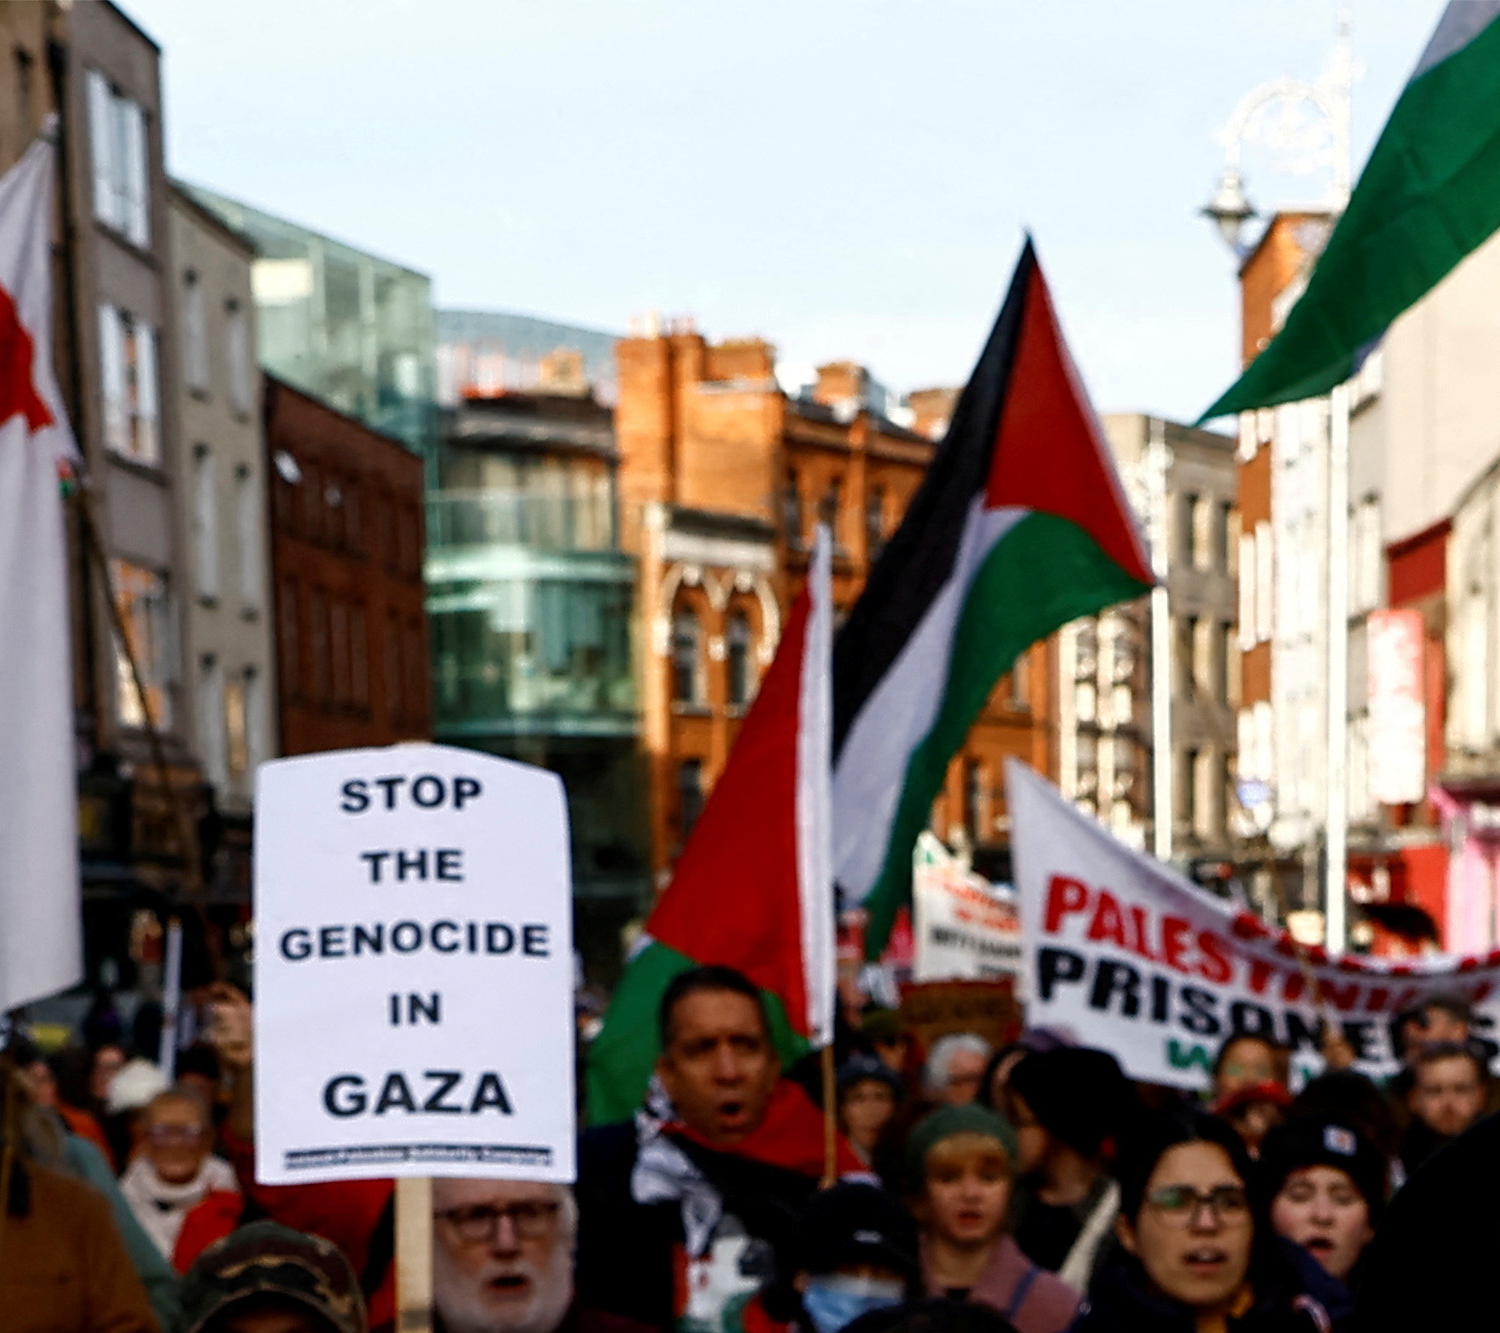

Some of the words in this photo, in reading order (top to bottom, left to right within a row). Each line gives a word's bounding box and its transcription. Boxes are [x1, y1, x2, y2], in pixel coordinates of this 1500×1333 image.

[340, 774, 482, 814] STOP
[362, 848, 464, 884] THE
[280, 920, 551, 961] GENOCIDE
[390, 992, 441, 1027] IN
[323, 1070, 514, 1117] GAZA
